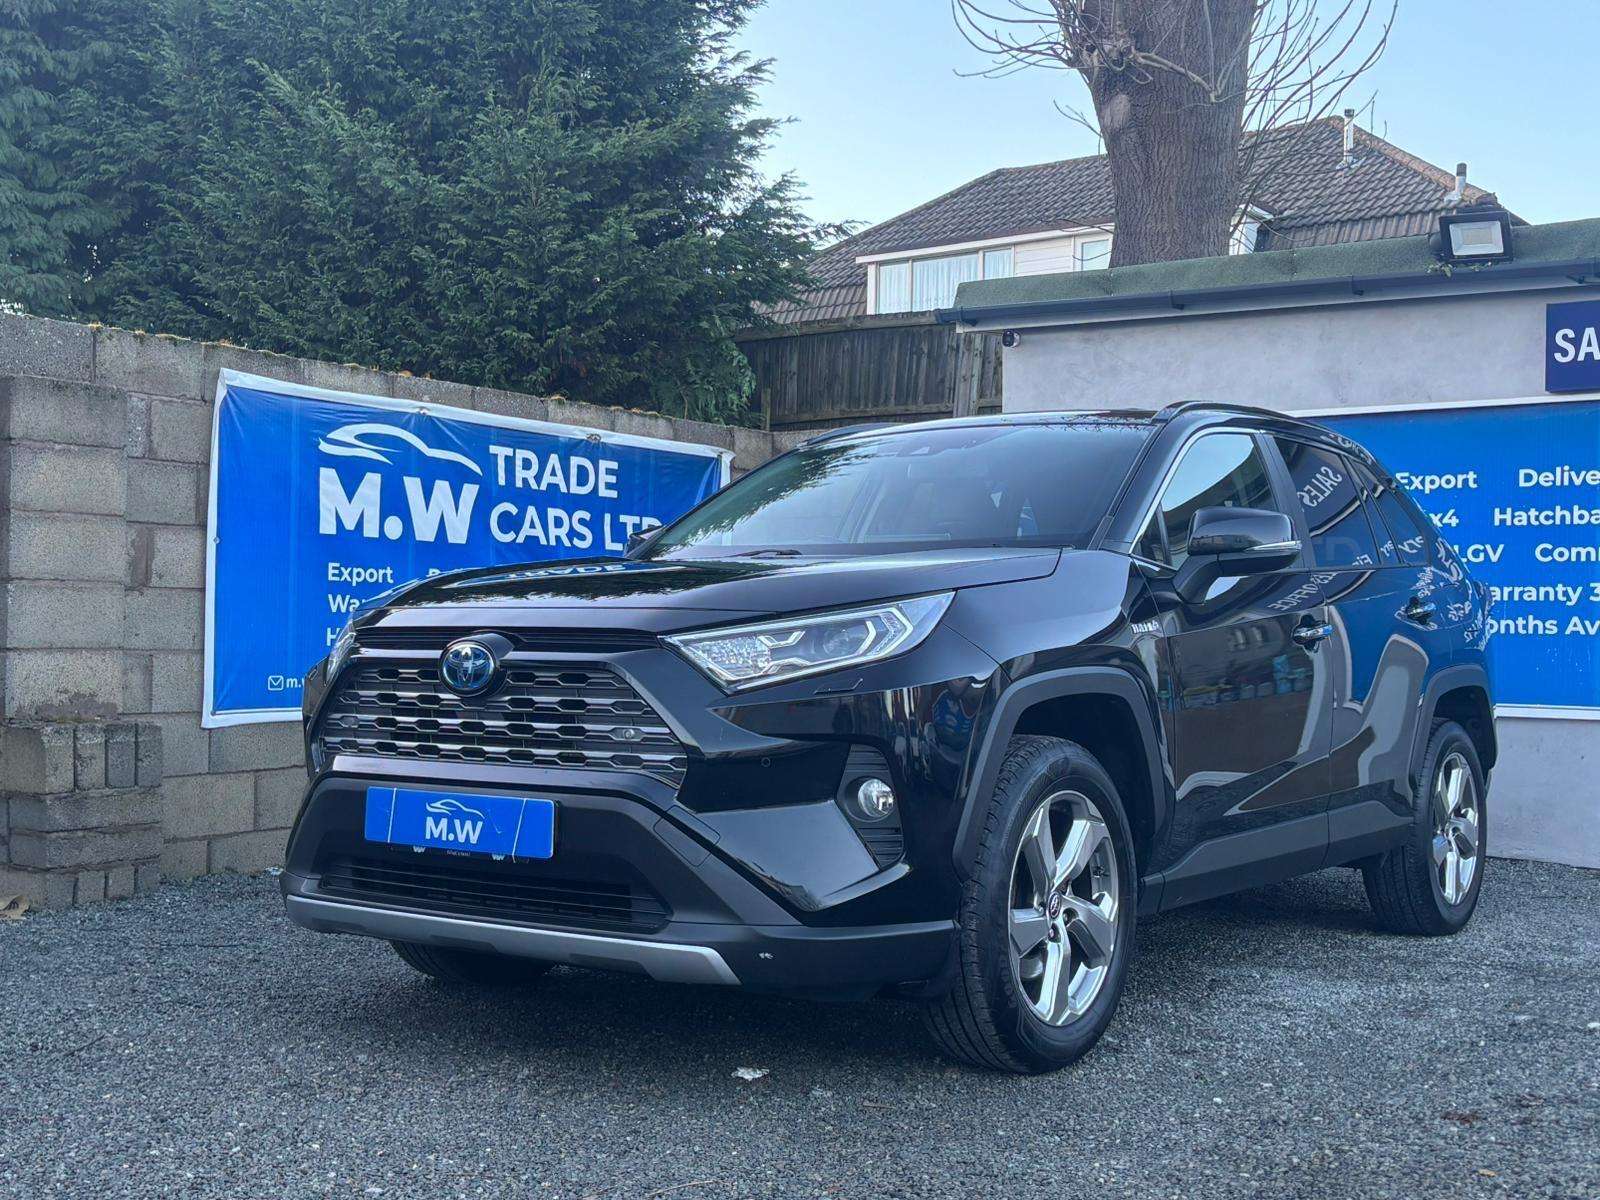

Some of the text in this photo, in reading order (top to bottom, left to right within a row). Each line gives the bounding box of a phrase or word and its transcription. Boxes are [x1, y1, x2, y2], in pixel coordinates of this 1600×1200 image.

[1554, 327, 1600, 363] SA
[489, 445, 619, 498] TRADE
[1396, 465, 1600, 494] Export Delive
[319, 467, 480, 544] M.W
[1428, 505, 1600, 528] x4 Hatchba
[489, 503, 593, 550] CARS
[1534, 543, 1600, 563] Com
[327, 562, 394, 587] Export
[1489, 583, 1583, 606] arranty
[1487, 614, 1558, 635] onths
[425, 816, 484, 845] M.W
